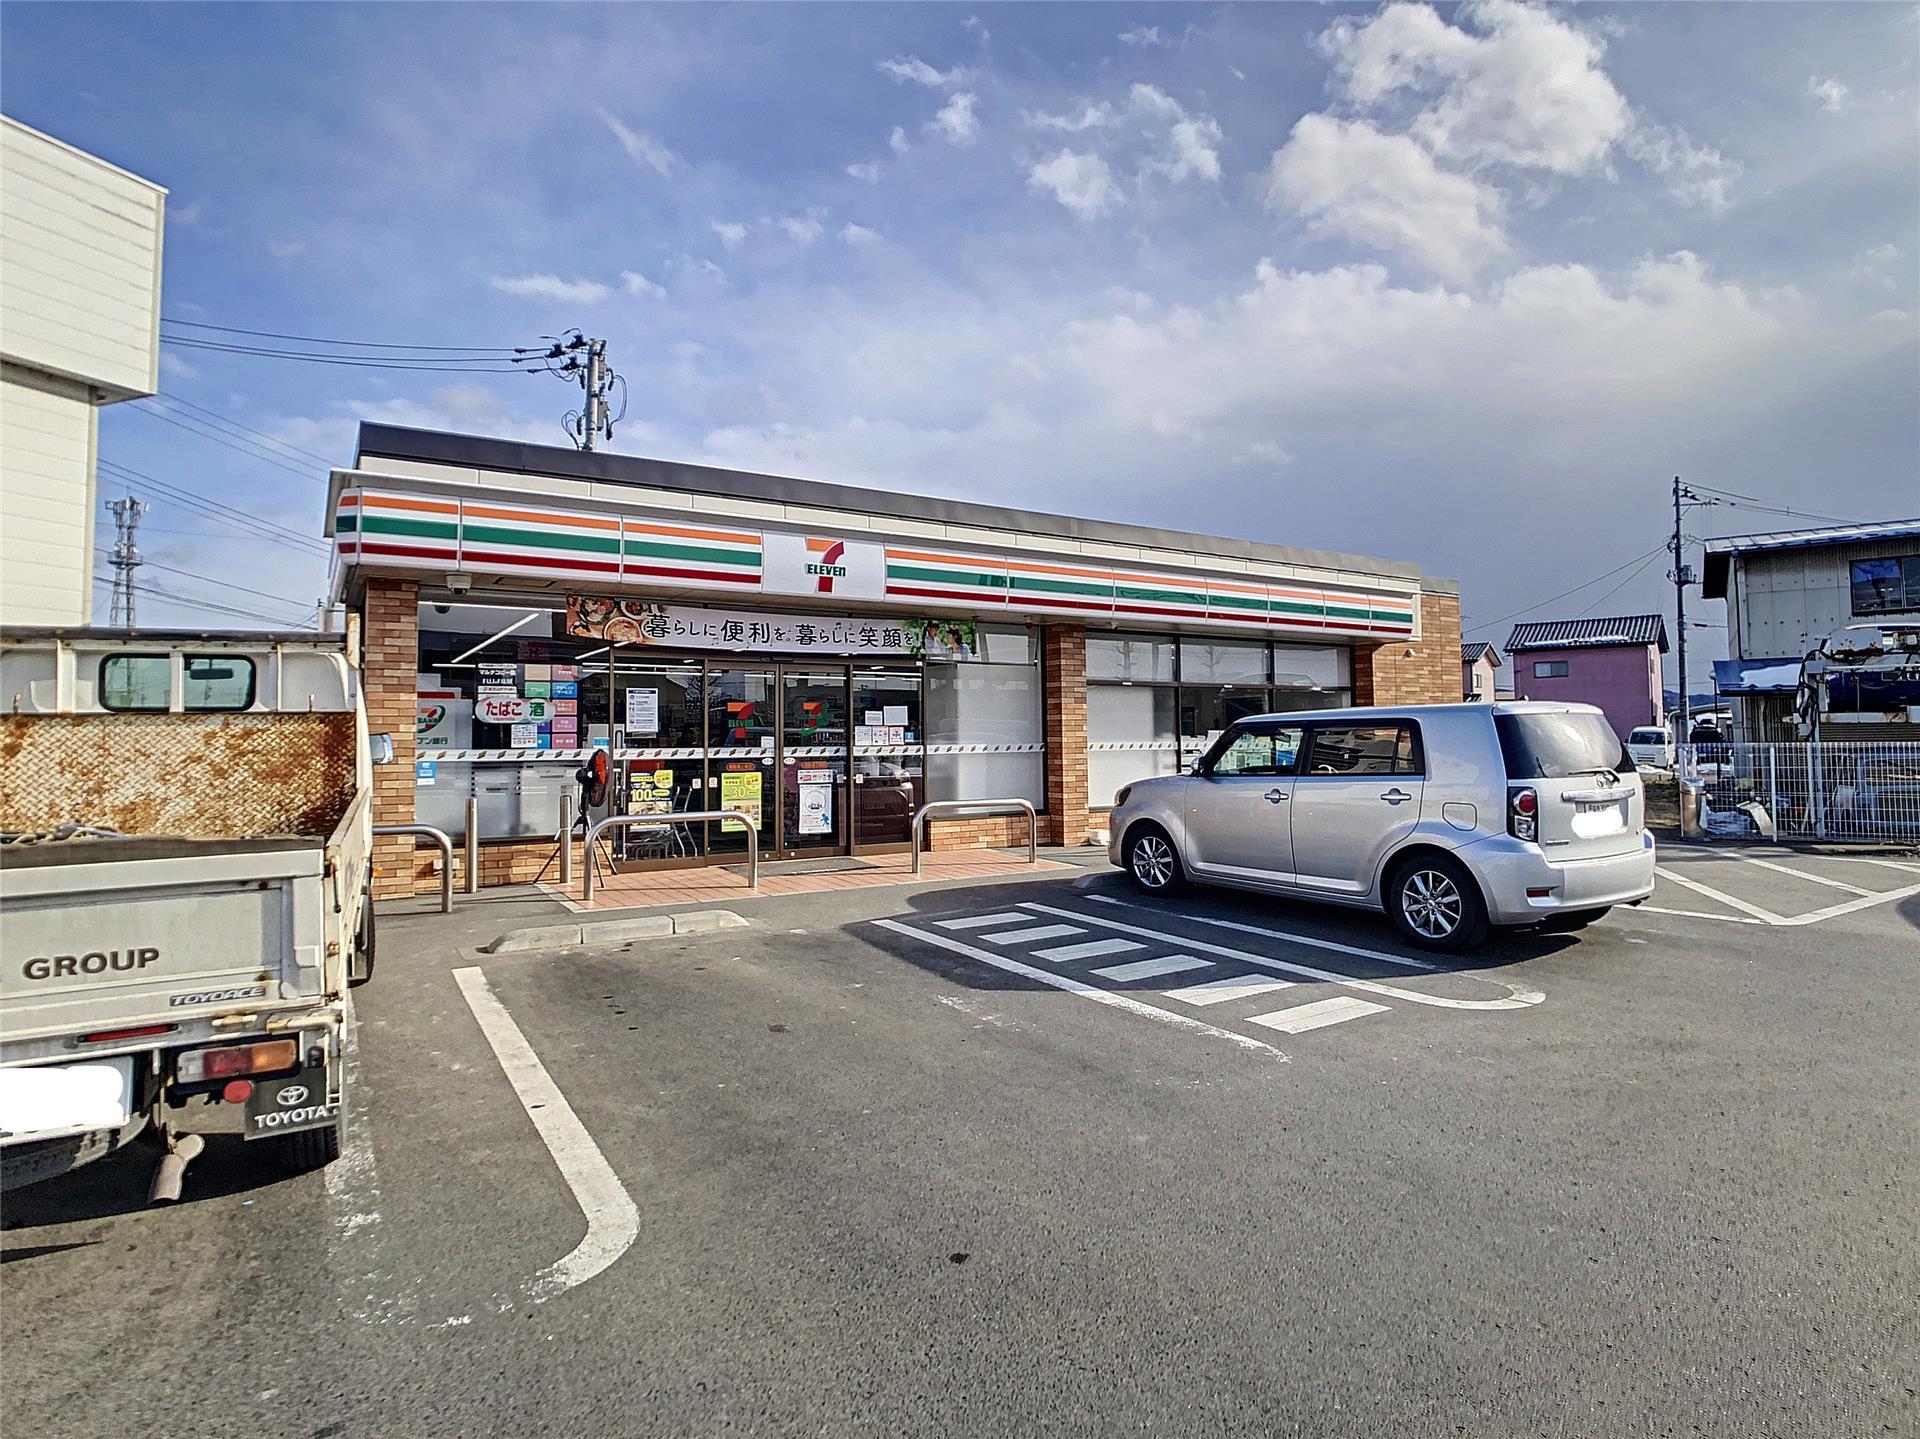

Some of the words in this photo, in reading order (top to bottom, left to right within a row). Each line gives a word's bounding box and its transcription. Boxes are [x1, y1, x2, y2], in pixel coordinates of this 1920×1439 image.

[486, 701, 523, 716] たばこ
[529, 702, 545, 716] 酒
[22, 948, 160, 980] GROUP
[171, 986, 265, 1005] TOYOACE
[254, 1105, 327, 1129] TOYOTA
